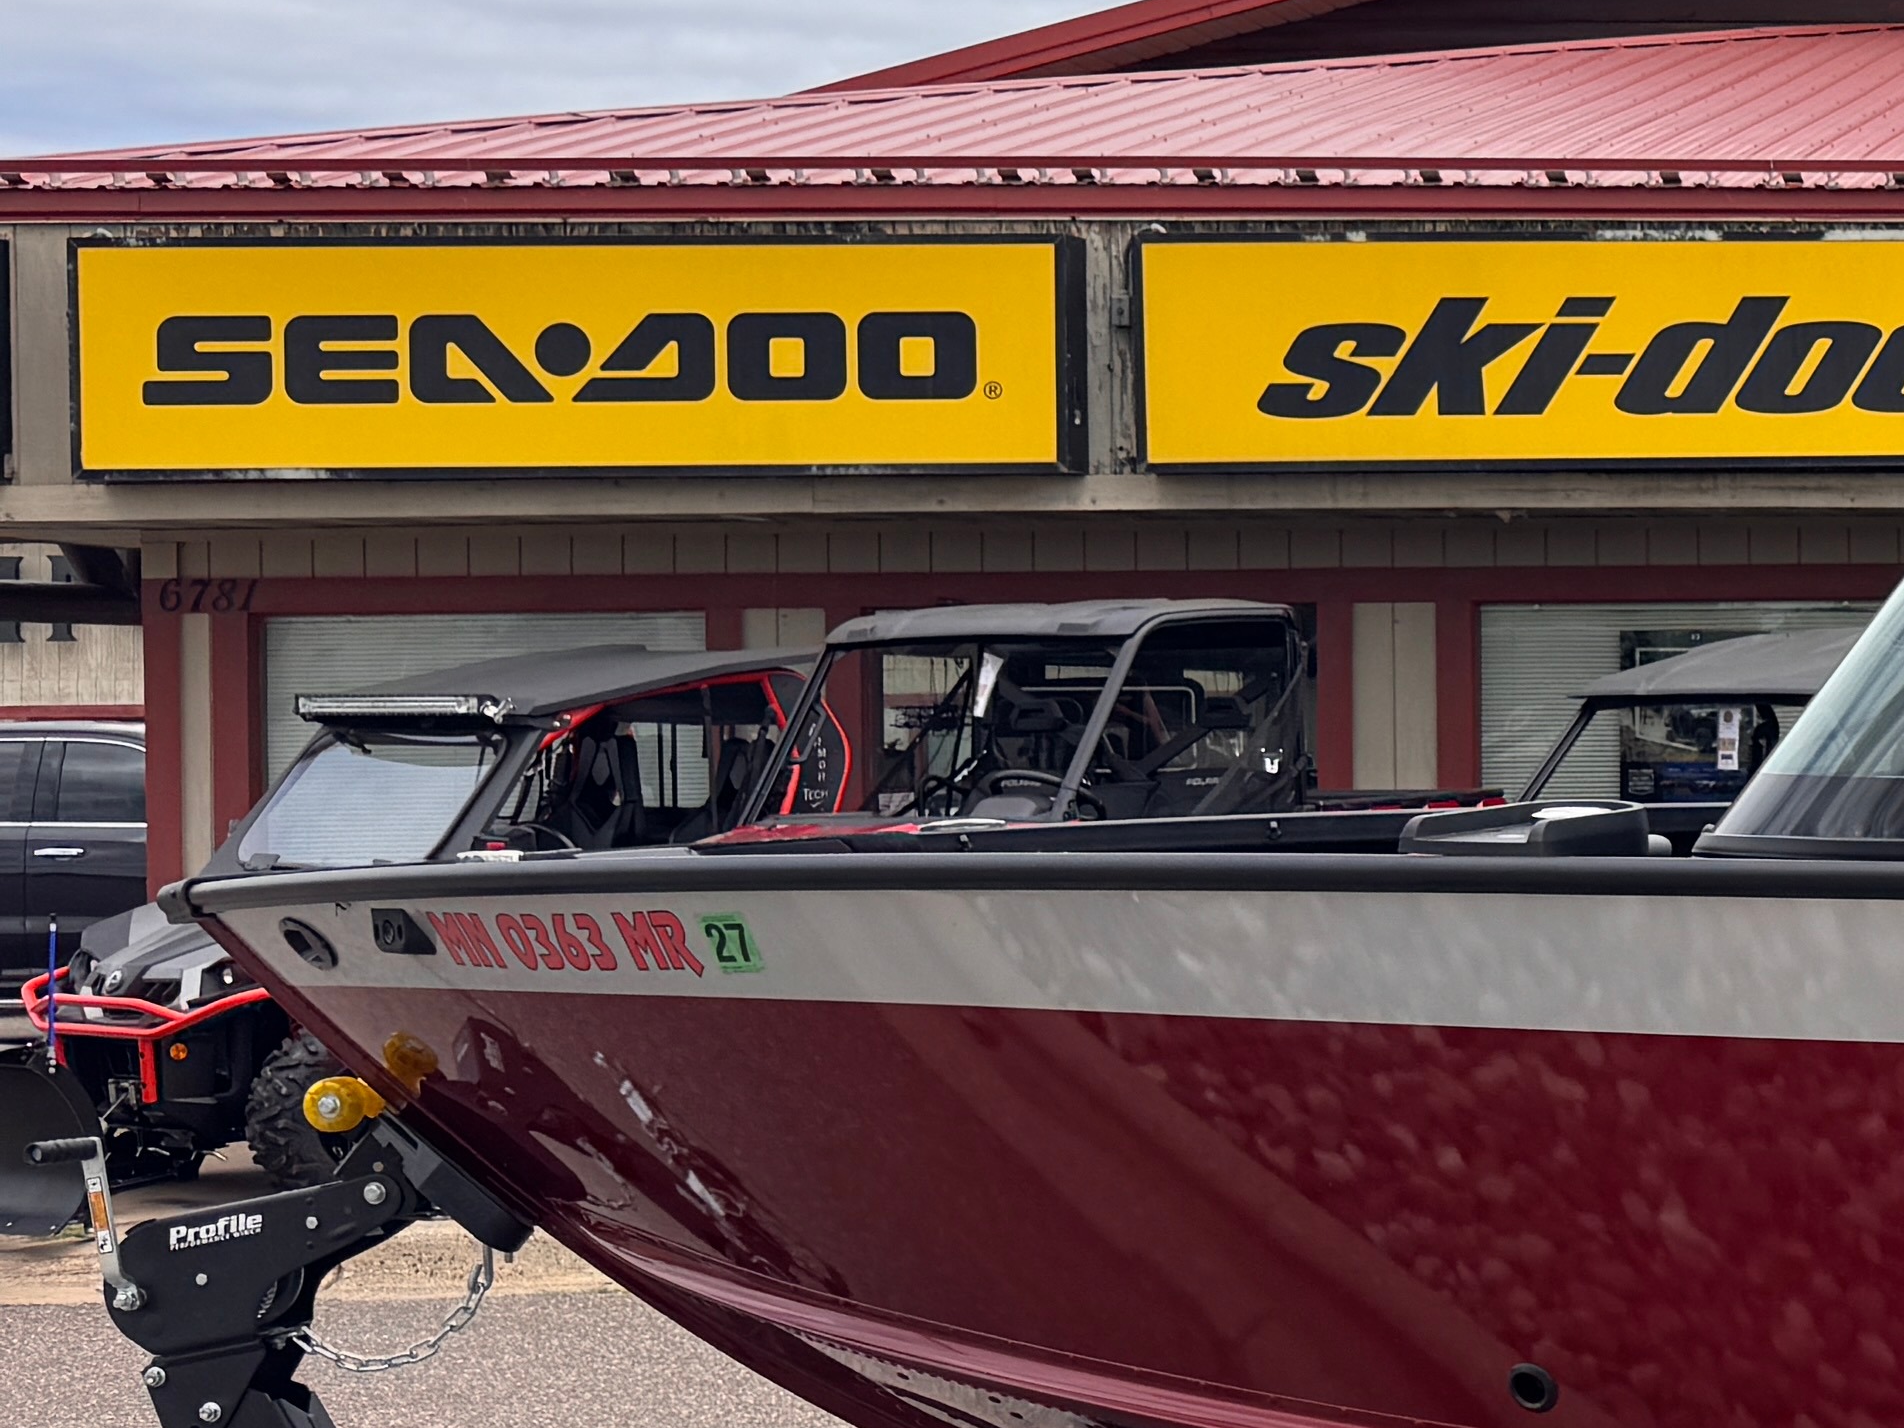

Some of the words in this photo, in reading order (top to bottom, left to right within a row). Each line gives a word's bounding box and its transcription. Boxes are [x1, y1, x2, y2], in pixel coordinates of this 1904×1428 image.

[159, 578, 260, 613] 6781
[425, 911, 508, 969] MN
[495, 912, 619, 971] 0363
[610, 910, 705, 978] MR
[704, 923, 752, 963] 27
[169, 1213, 263, 1245] Profile
